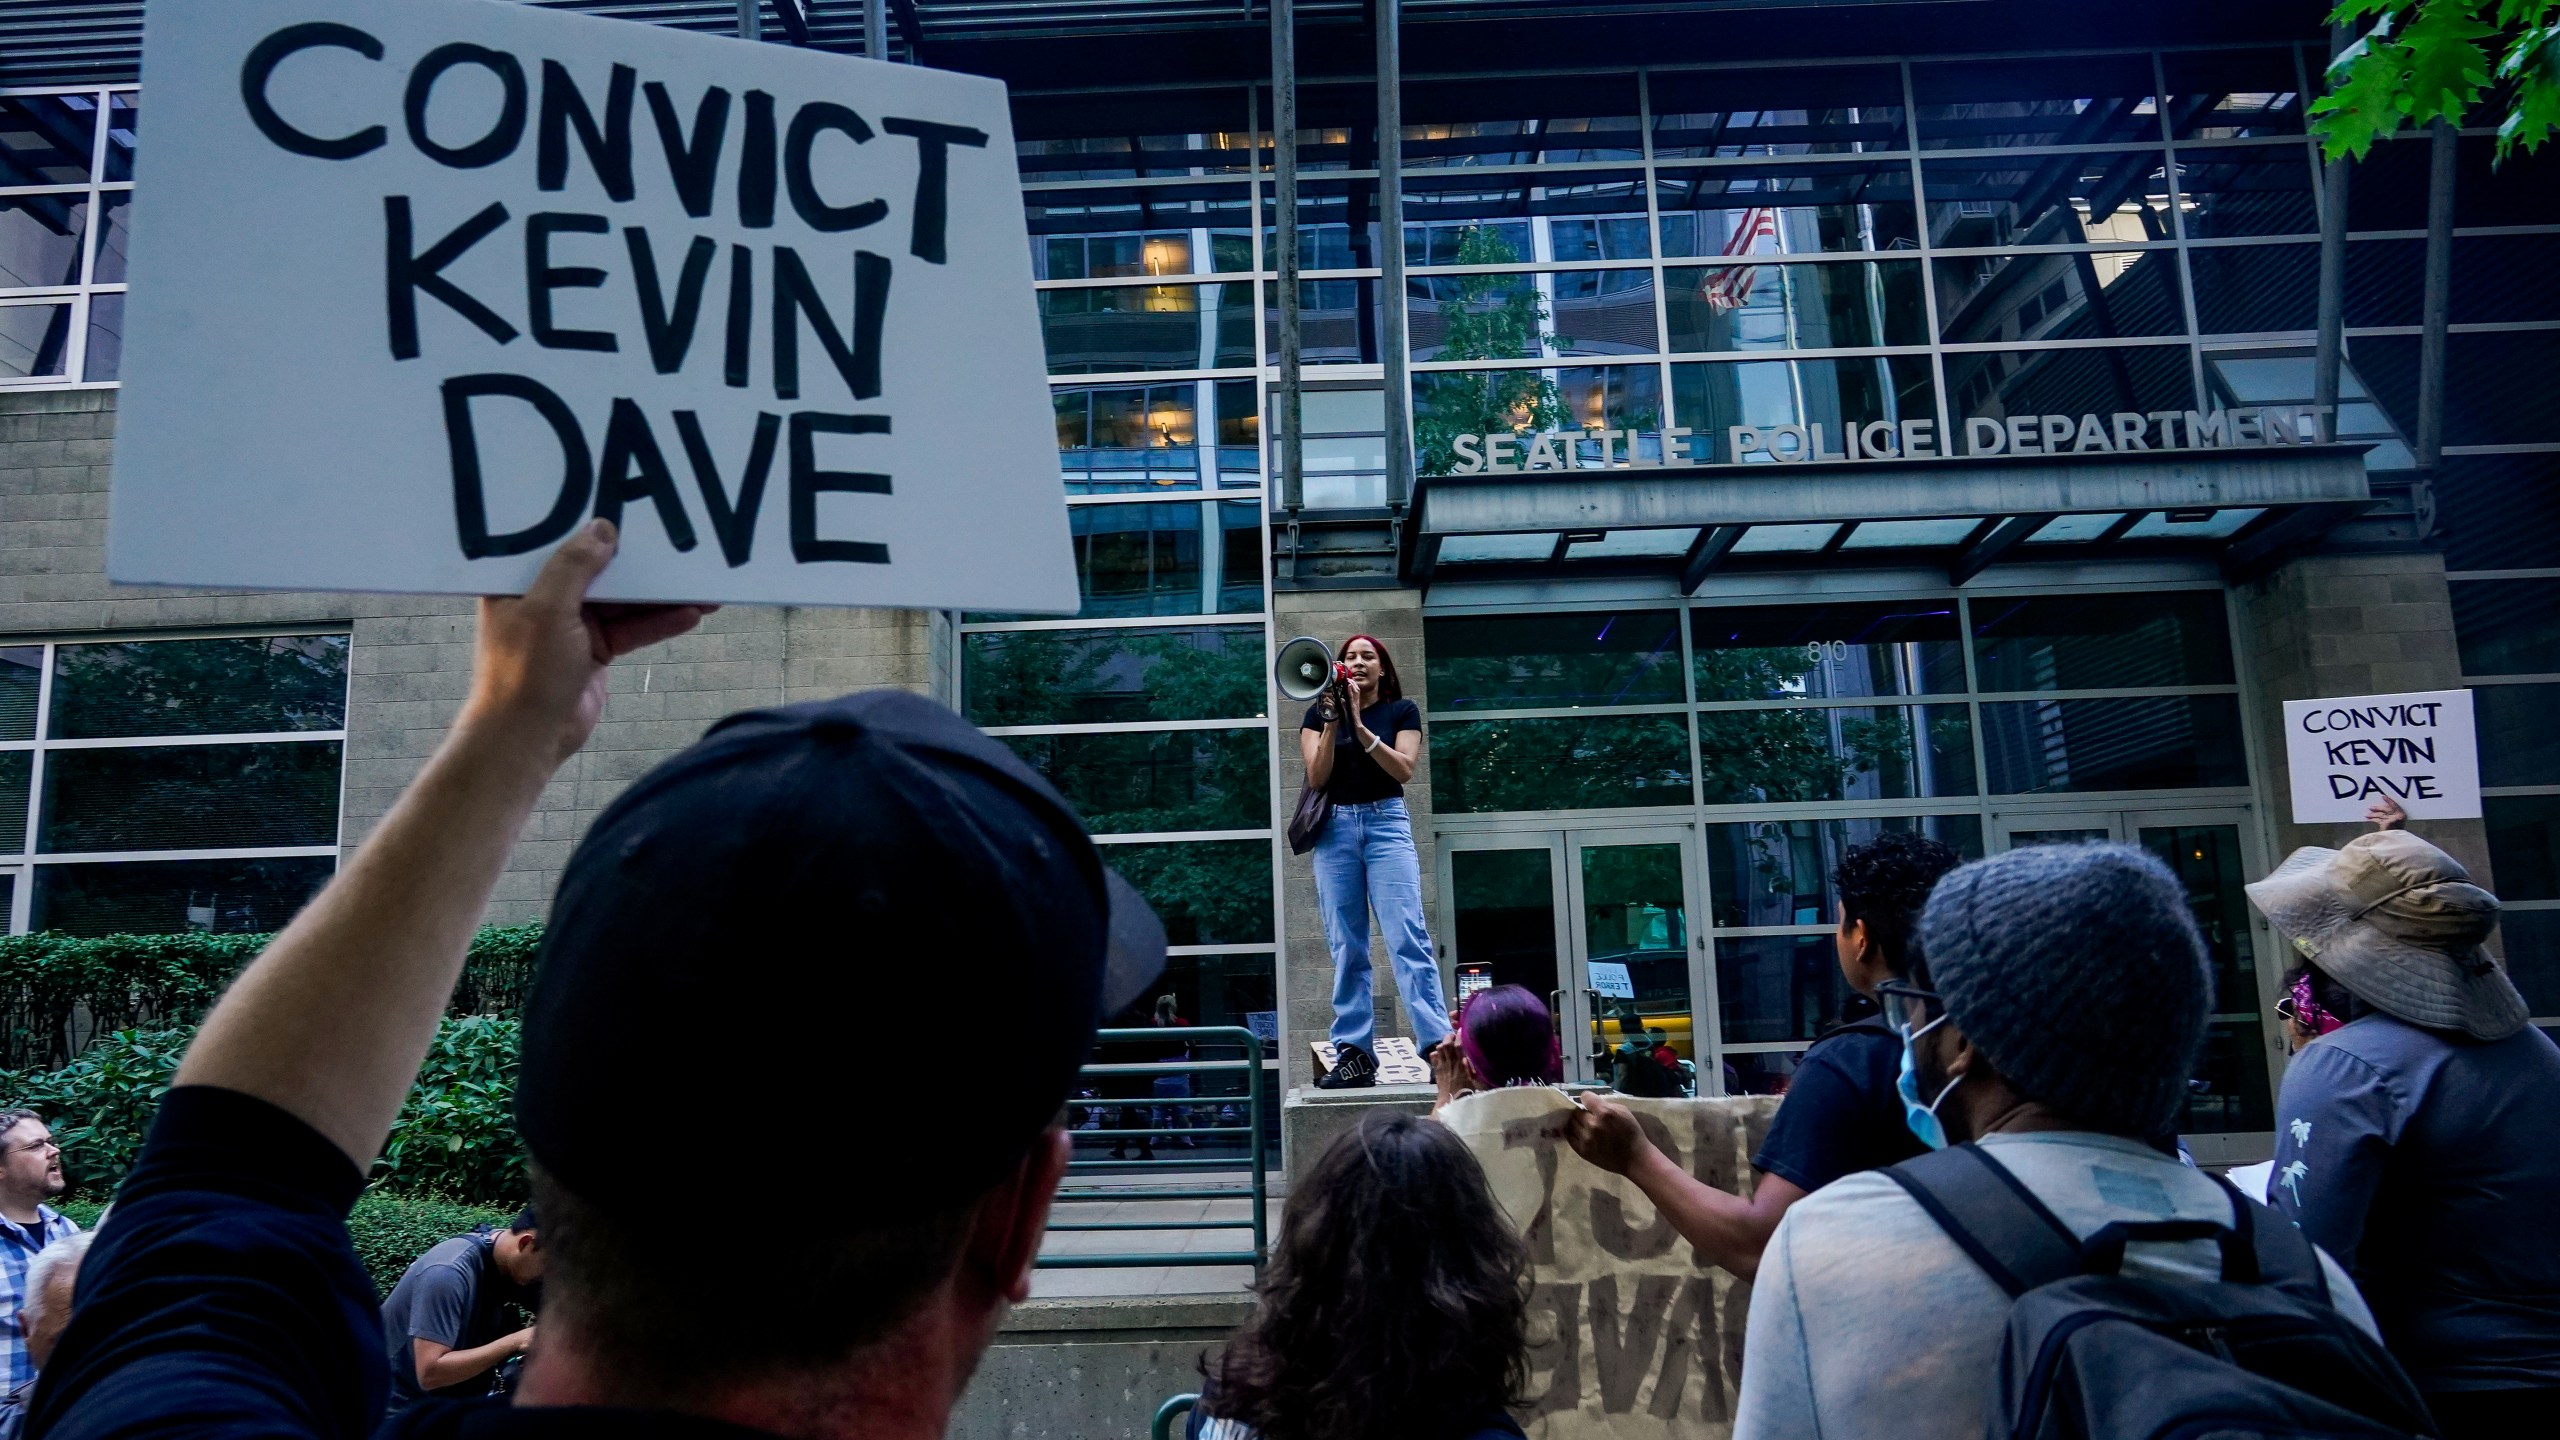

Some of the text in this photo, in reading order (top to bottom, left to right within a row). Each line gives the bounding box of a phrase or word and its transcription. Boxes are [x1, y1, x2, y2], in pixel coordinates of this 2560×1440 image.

[241, 22, 989, 264] CONVICT
[383, 195, 892, 400] KEVIN
[1453, 404, 2334, 474] SEATTLE POLICE DEPARTMENT
[440, 373, 892, 567] DAVE
[1807, 640, 1847, 662] 810
[2303, 702, 2442, 733] CONVICT
[2323, 736, 2436, 765] KEVIN
[2328, 774, 2443, 800] DAVE
